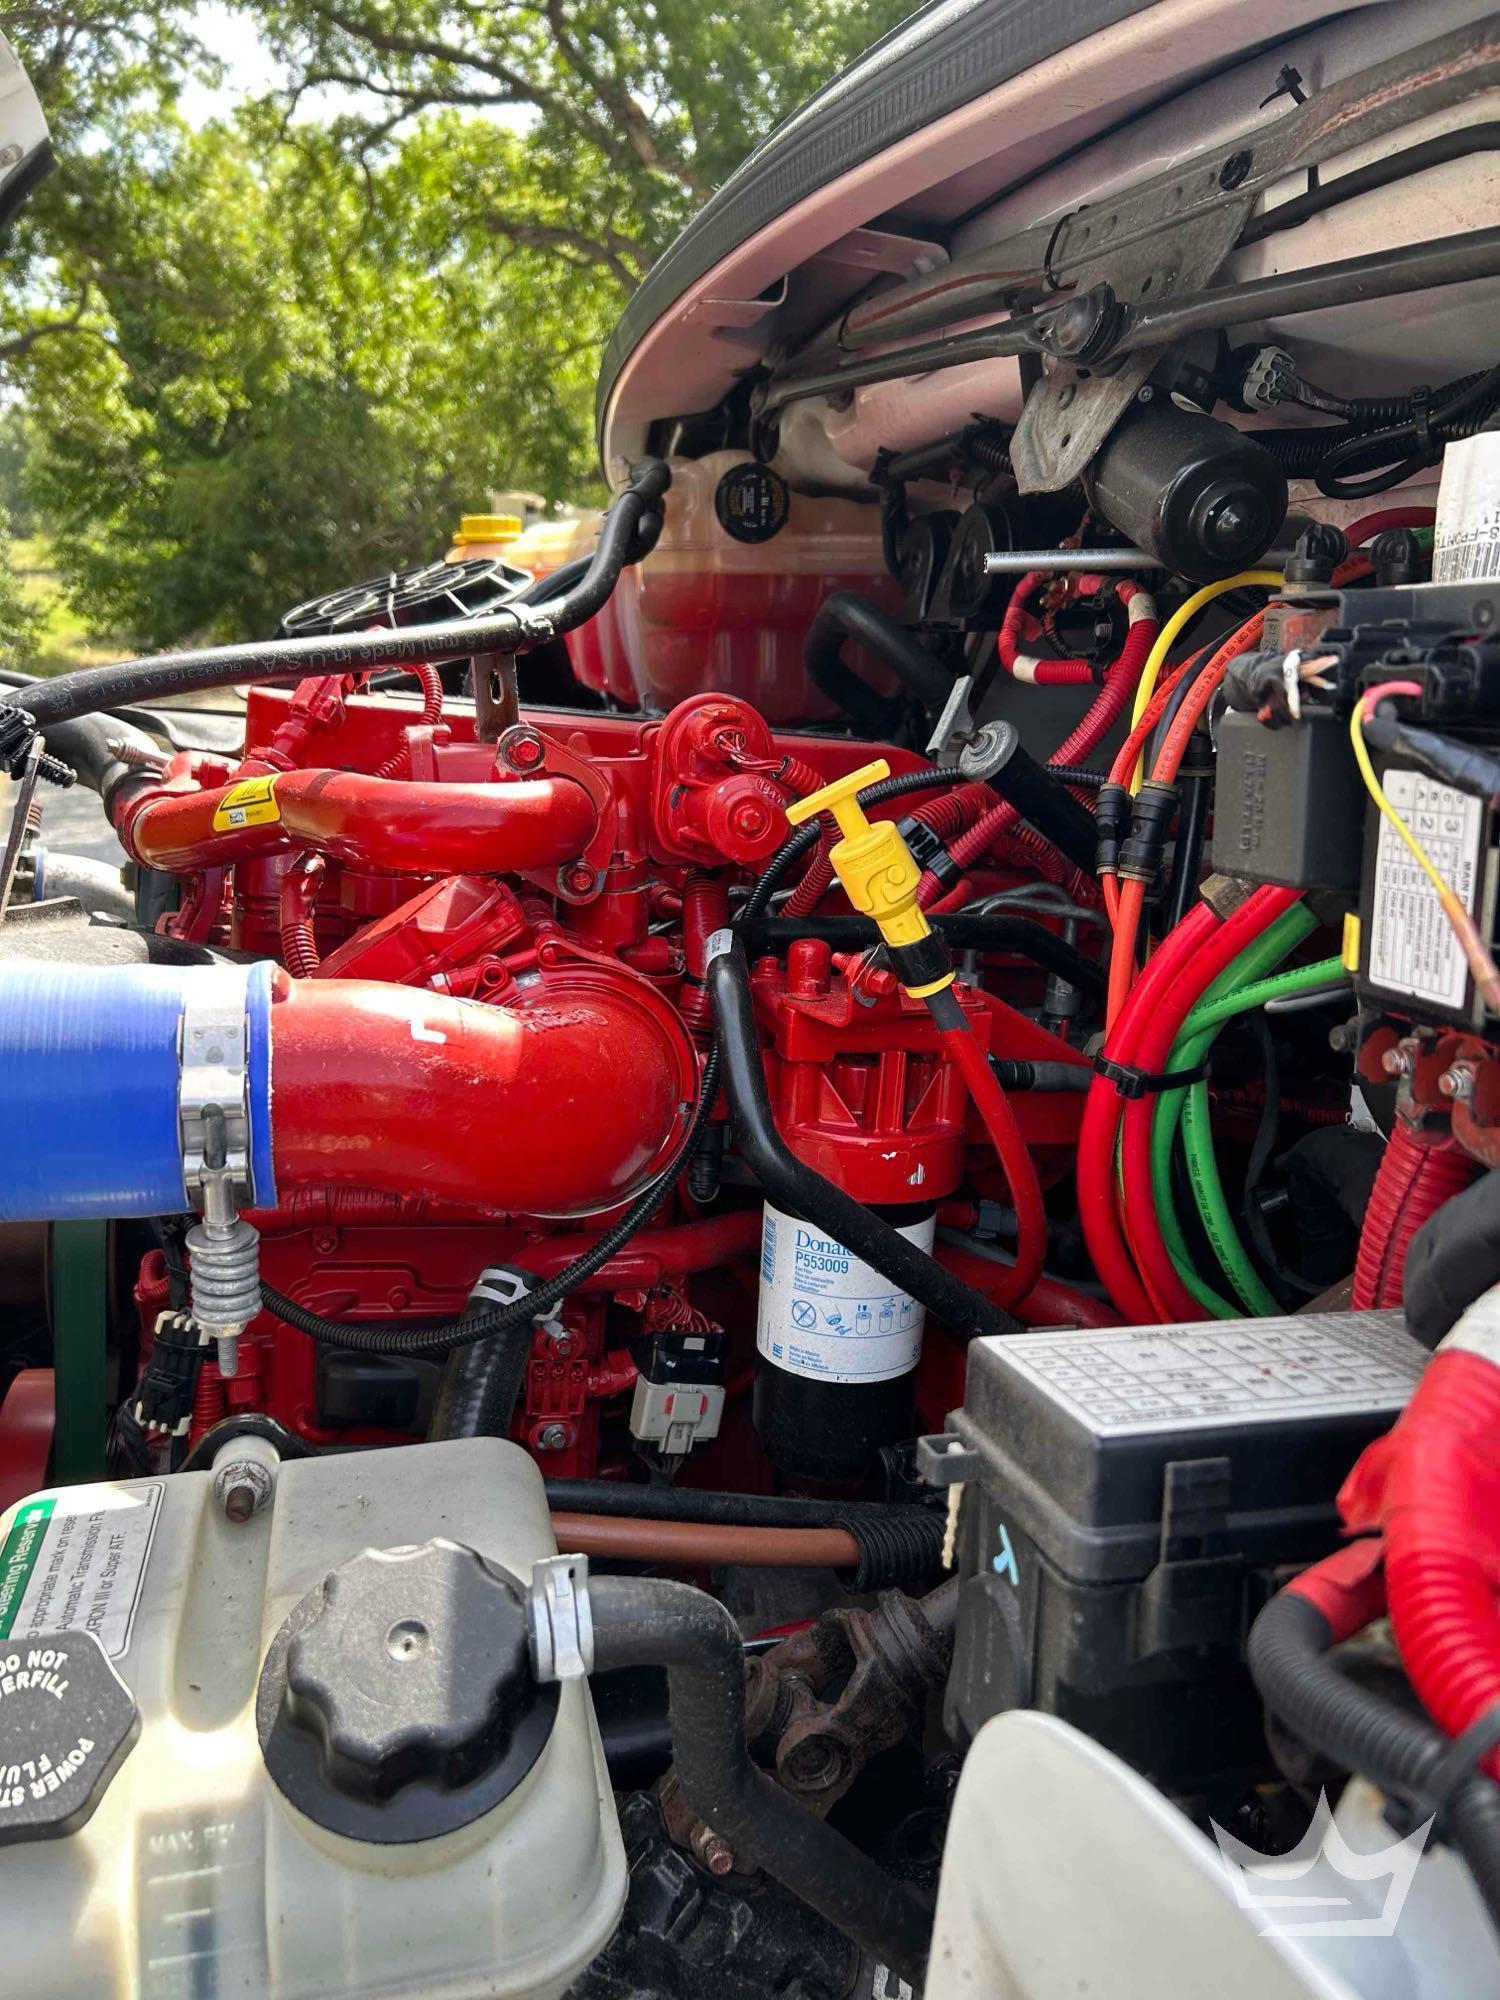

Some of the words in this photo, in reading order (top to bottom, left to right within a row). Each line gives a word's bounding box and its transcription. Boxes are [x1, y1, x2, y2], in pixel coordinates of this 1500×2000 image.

[334, 647, 353, 664] in
[358, 643, 416, 662] Made
[1420, 815, 1436, 830] 2
[1445, 819, 1460, 832] 3
[1462, 861, 1472, 890] MAIN
[795, 1250, 849, 1274] P553009
[108, 1530, 127, 1551] ATF.
[56, 1581, 85, 1630] Automatic
[71, 1524, 102, 1581] Transmission
[100, 1553, 121, 1579] Super
[30, 1574, 59, 1628] appropriate
[48, 1549, 67, 1573] mark
[58, 1536, 71, 1549] on
[101, 1579, 114, 1590] or
[27, 1649, 69, 1671] NOT
[0, 1670, 69, 1700] ERFILL
[29, 1737, 96, 1800] POWER
